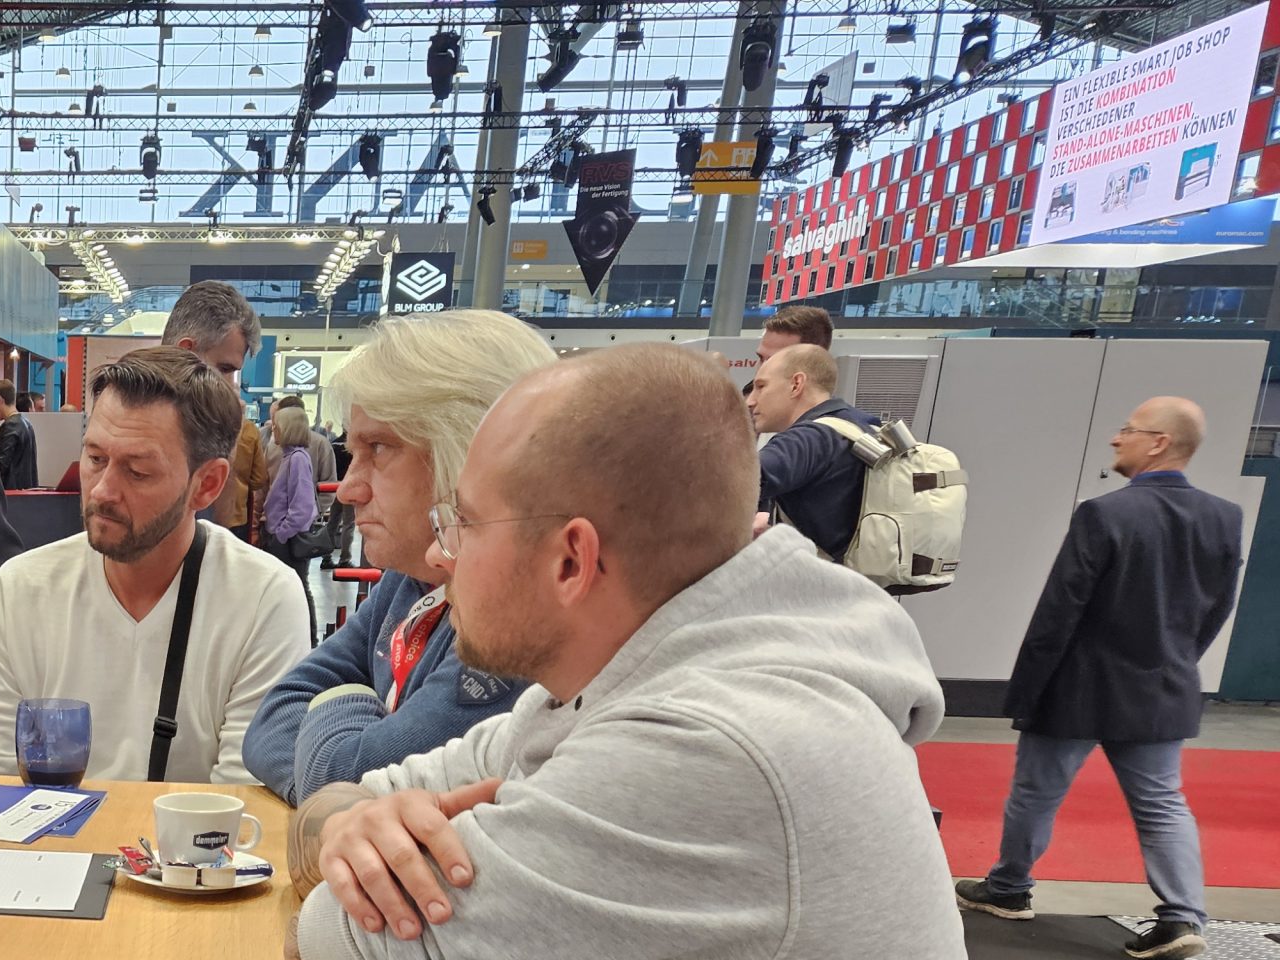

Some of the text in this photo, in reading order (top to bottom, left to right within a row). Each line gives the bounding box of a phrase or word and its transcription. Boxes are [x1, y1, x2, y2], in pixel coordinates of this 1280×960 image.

[1063, 26, 1231, 103] EIN FLEXIBLE SMART JOB SHOP
[1060, 66, 1176, 122] IST DIE KOMBINATION
[1049, 107, 1237, 178] DIE ZUSAMMENARBEITEN KÖNNEN
[1052, 101, 1195, 160] STAND-ALONE-MASCHINEN,
[1057, 101, 1136, 141] VERSCHIEDENER
[602, 189, 628, 198] Fertigung
[782, 204, 870, 259] salvagnini
[394, 302, 444, 312] BLM GROUP
[727, 358, 757, 368] salv
[463, 677, 485, 699] CND
